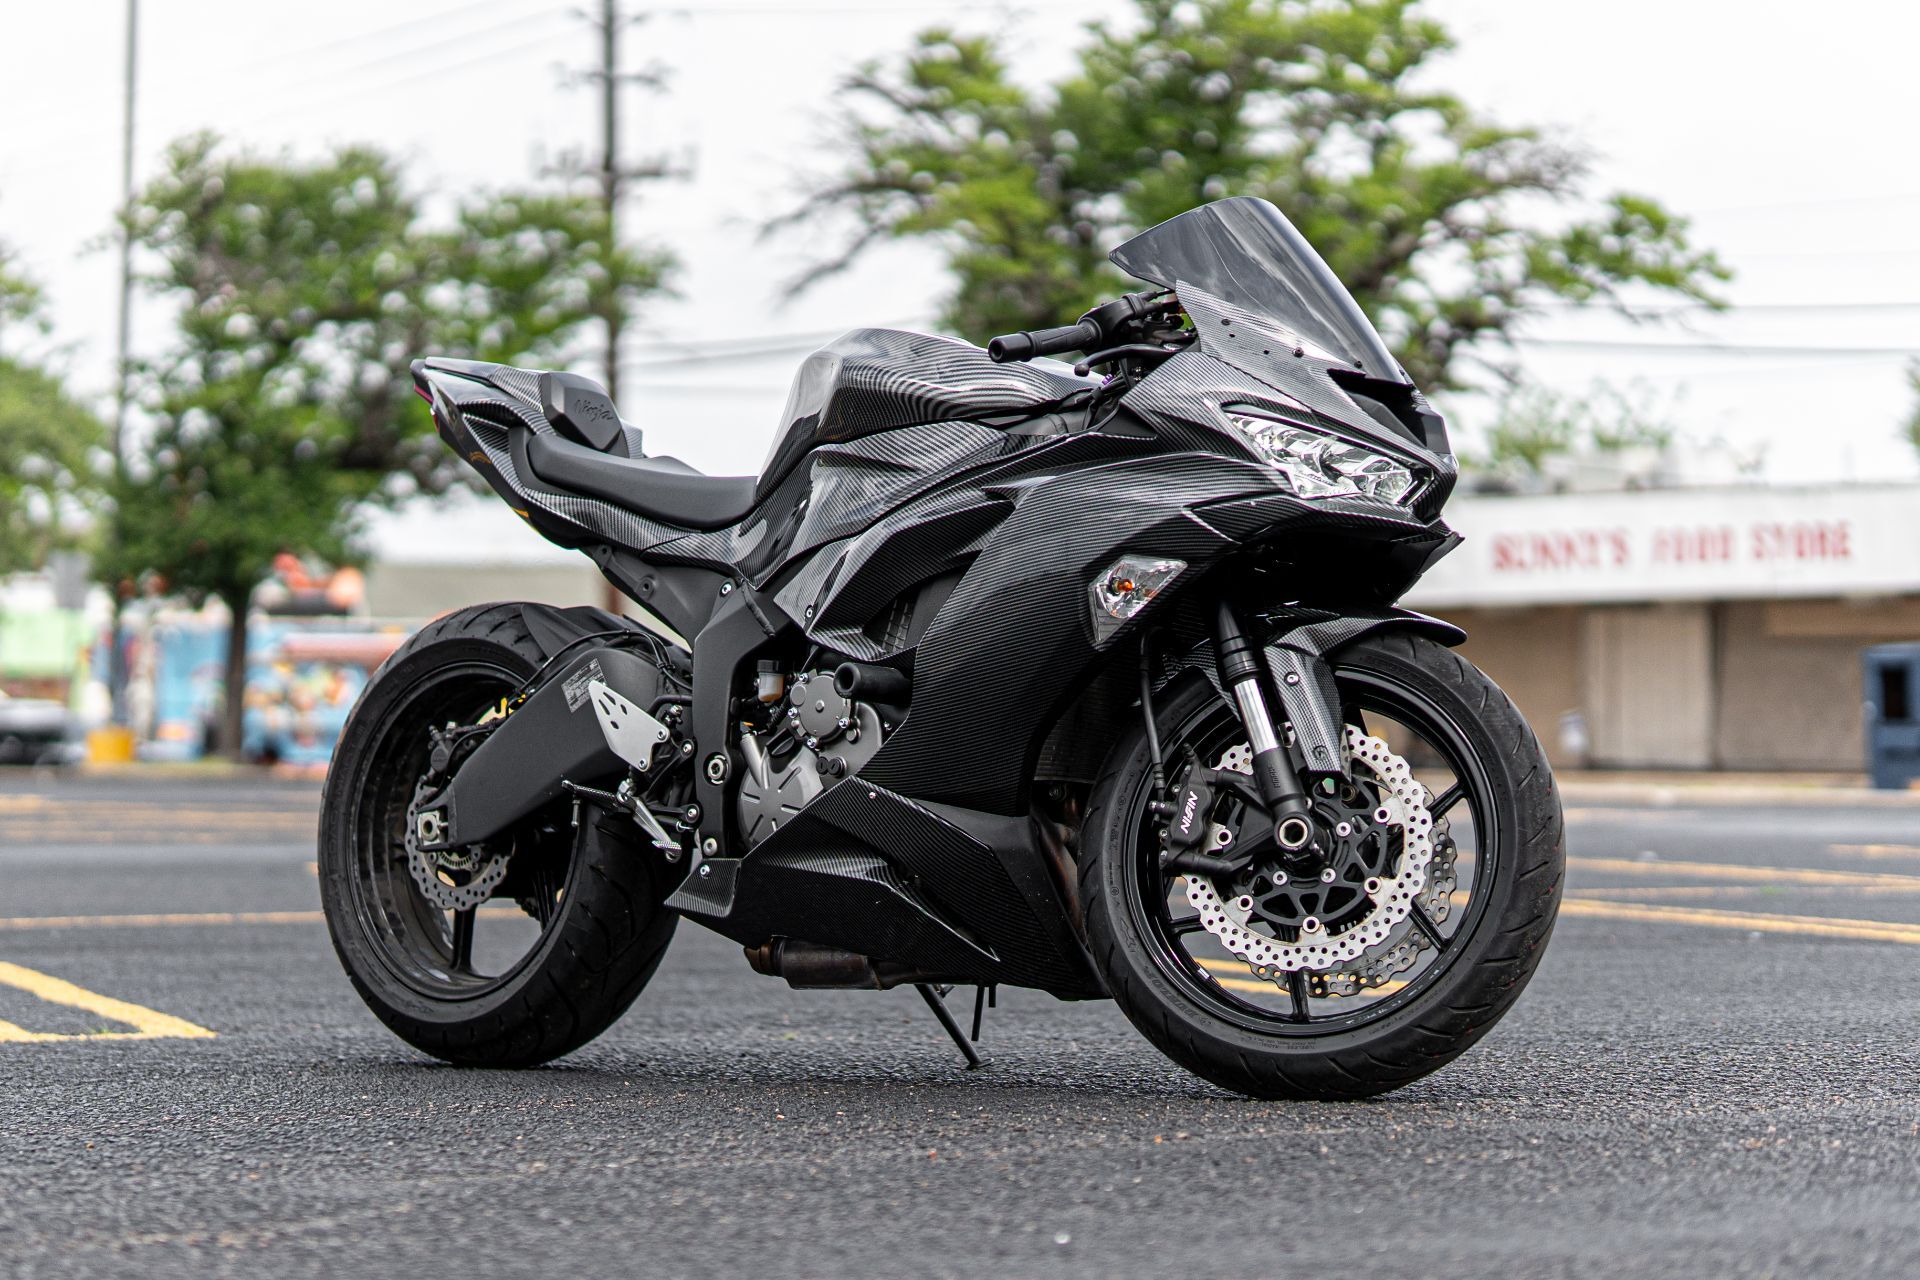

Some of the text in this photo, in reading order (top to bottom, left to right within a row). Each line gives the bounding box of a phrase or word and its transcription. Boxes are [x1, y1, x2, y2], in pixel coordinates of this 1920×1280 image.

[574, 398, 615, 423] Ninja
[1752, 520, 1852, 561] STORE
[1180, 790, 1198, 835] NISSIN
